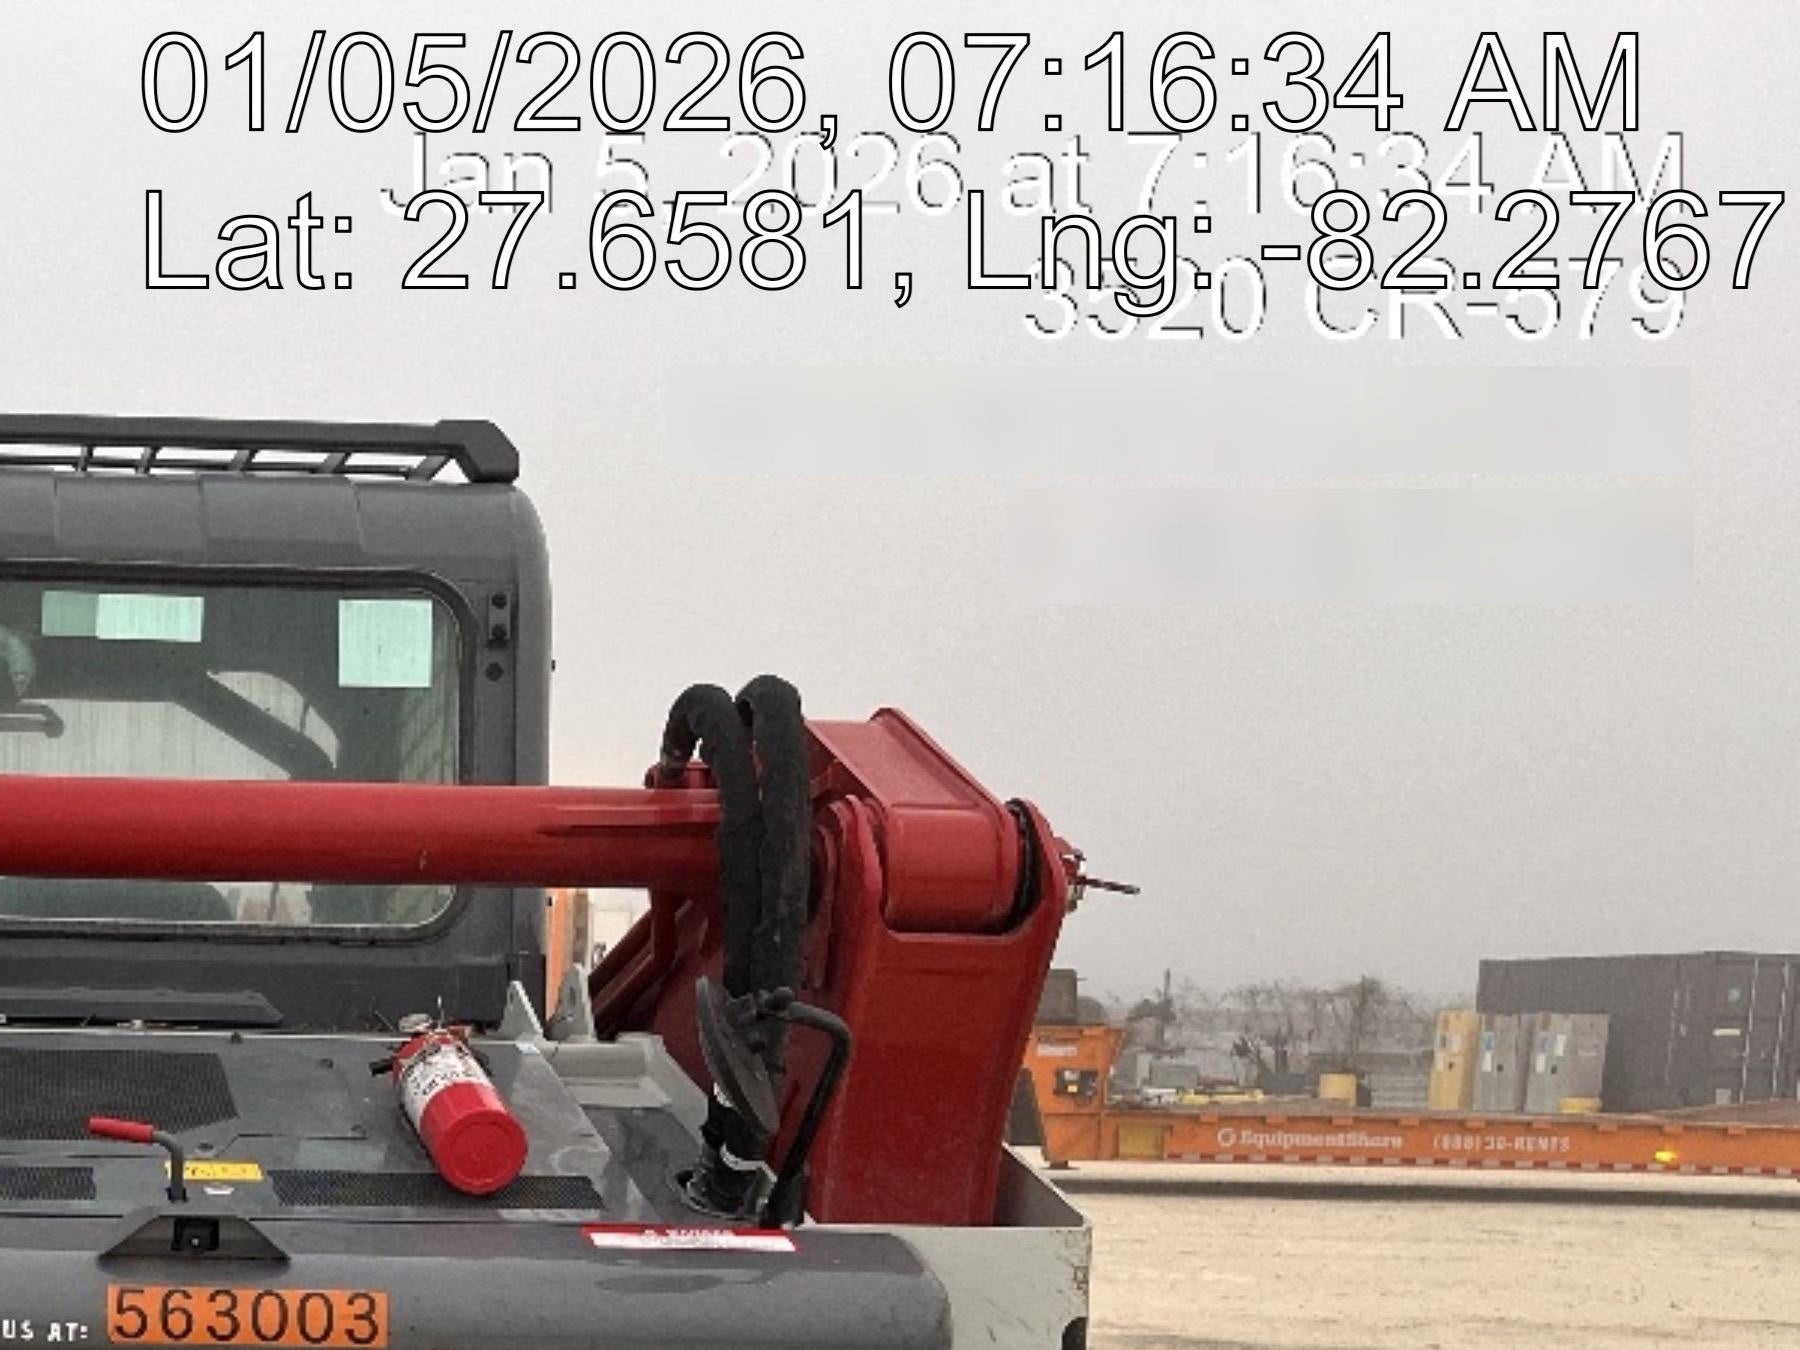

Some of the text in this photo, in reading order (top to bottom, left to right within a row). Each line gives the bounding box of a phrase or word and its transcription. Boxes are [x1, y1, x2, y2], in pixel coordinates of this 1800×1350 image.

[2, 1319, 34, 1341] US
[47, 1322, 88, 1342] AT:
[114, 1288, 381, 1347] 563003
